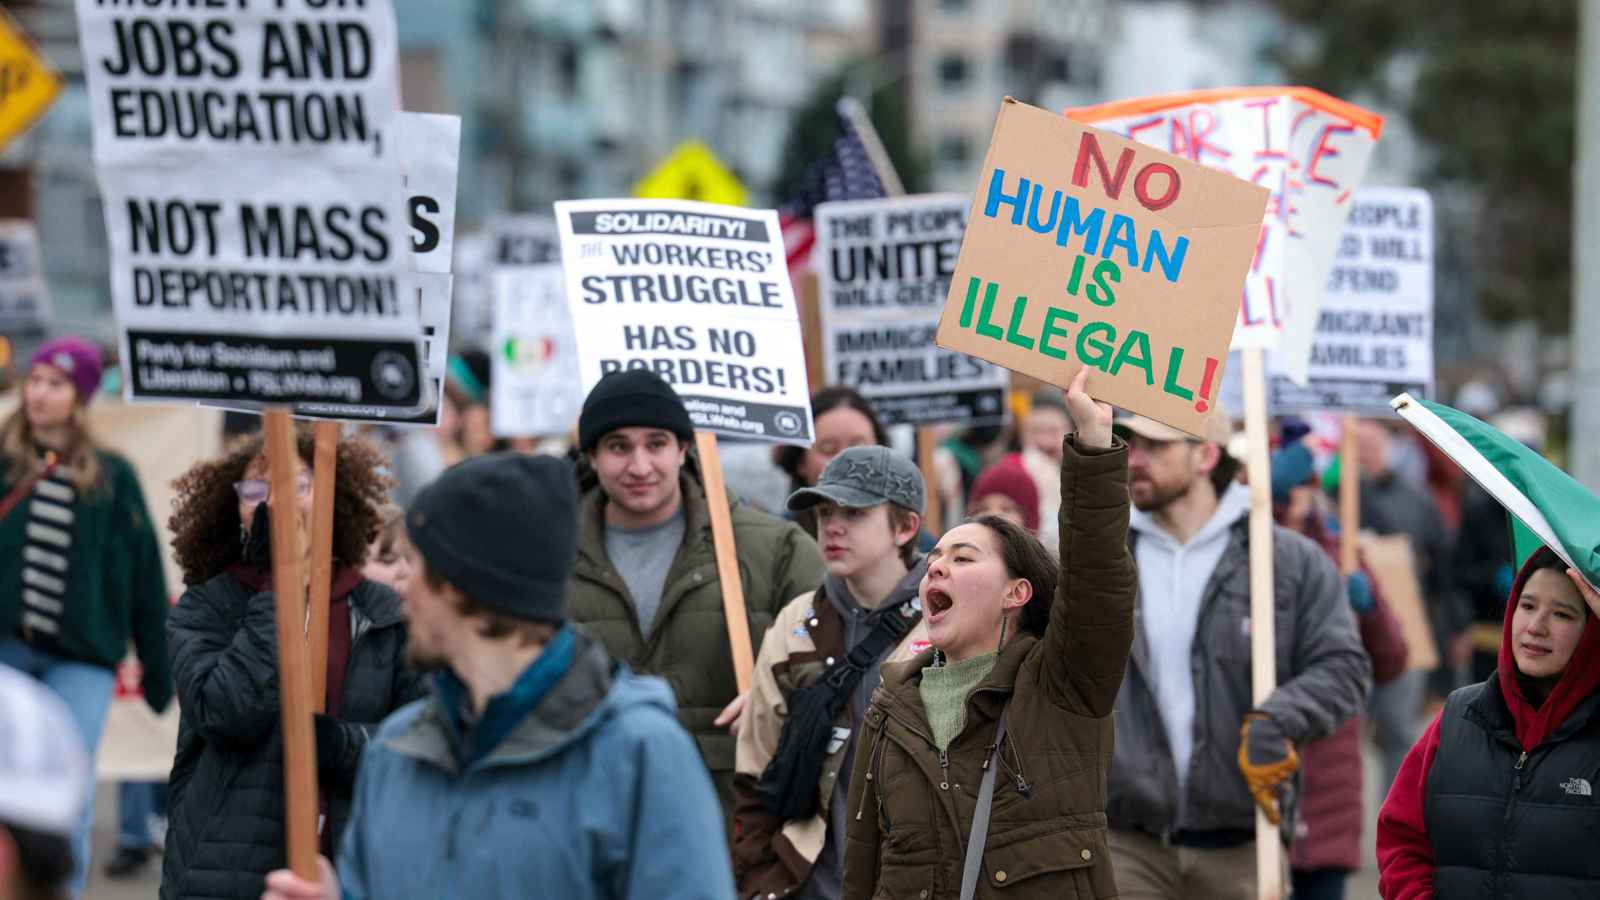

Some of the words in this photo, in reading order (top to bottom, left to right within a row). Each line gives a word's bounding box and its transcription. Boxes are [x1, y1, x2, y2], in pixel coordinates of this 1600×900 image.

[103, 19, 241, 80] JOBS
[261, 21, 373, 80] AND
[111, 89, 382, 157] EDUCATION,
[1071, 131, 1181, 211] NO
[127, 199, 221, 257] NOT
[241, 203, 391, 264] MASS
[594, 212, 748, 239] SOLIDARITY!
[830, 214, 871, 238] THE
[984, 169, 1190, 282] HUMAN
[611, 243, 773, 273] WORKERS'
[831, 240, 960, 283] UNITE
[1067, 255, 1121, 307] IS
[132, 267, 401, 316] DEPORTATION!
[580, 274, 784, 309] STRUGGLE
[623, 324, 697, 351] HAS
[707, 328, 756, 358] NO
[959, 276, 1218, 413] ILLEGAL!
[1310, 343, 1406, 368] AMILIES
[838, 353, 984, 387] FAMILIES
